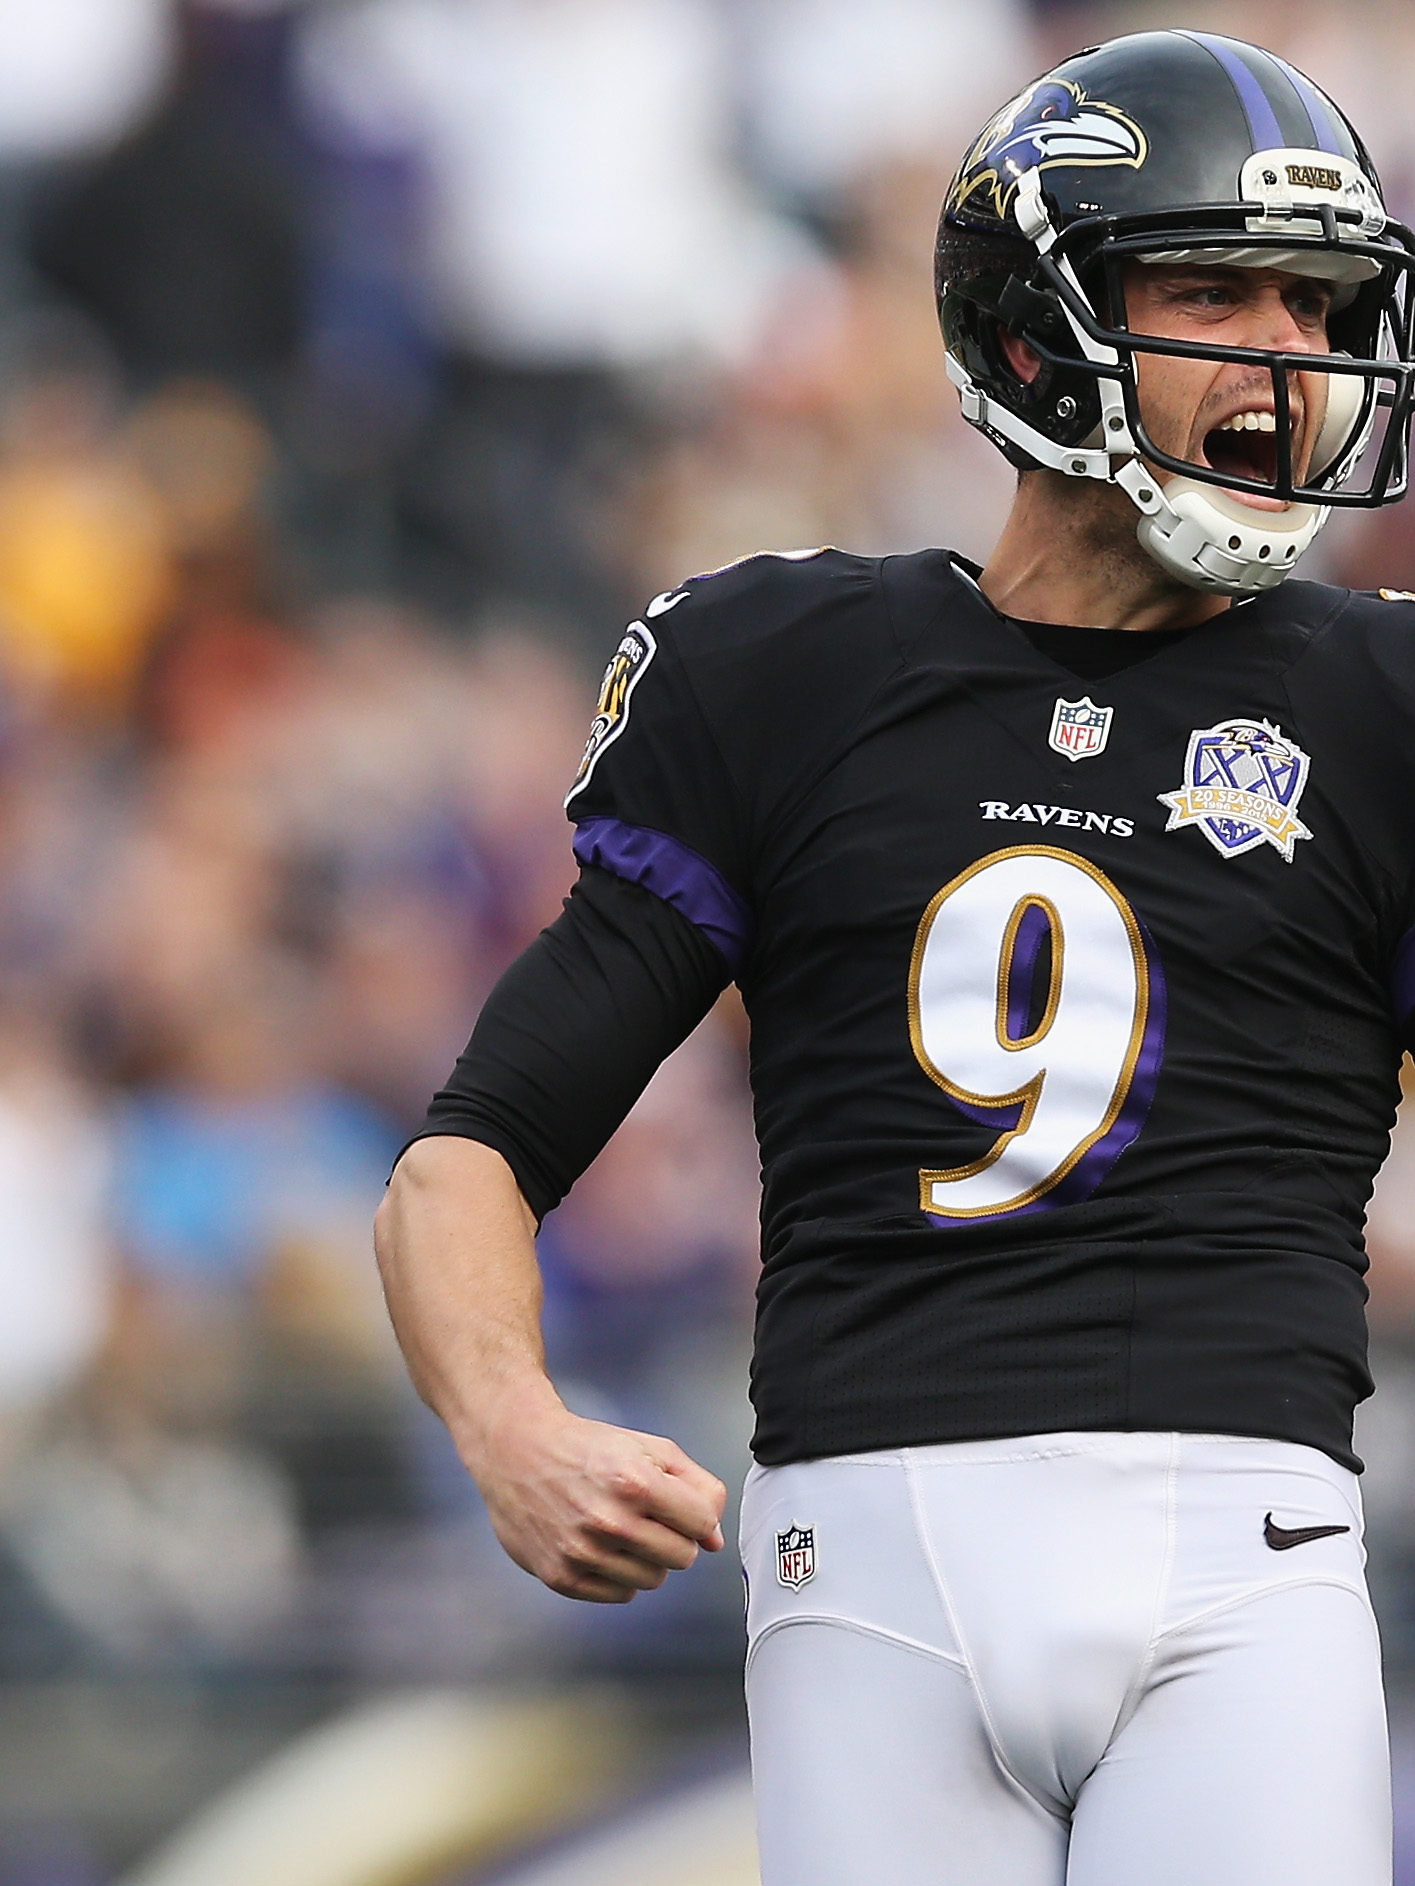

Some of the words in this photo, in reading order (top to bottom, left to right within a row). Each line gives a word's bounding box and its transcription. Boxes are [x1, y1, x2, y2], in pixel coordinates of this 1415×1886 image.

[1286, 165, 1342, 191] RAVENS
[1058, 724, 1097, 751] NFL
[978, 800, 1135, 838] RAVENS
[1194, 789, 1214, 803] 20
[1217, 790, 1284, 820] SEASONS
[1202, 801, 1231, 811] 1996
[1240, 806, 1268, 822] 2015
[907, 844, 1160, 1222] 9
[781, 1550, 812, 1580] NFL
